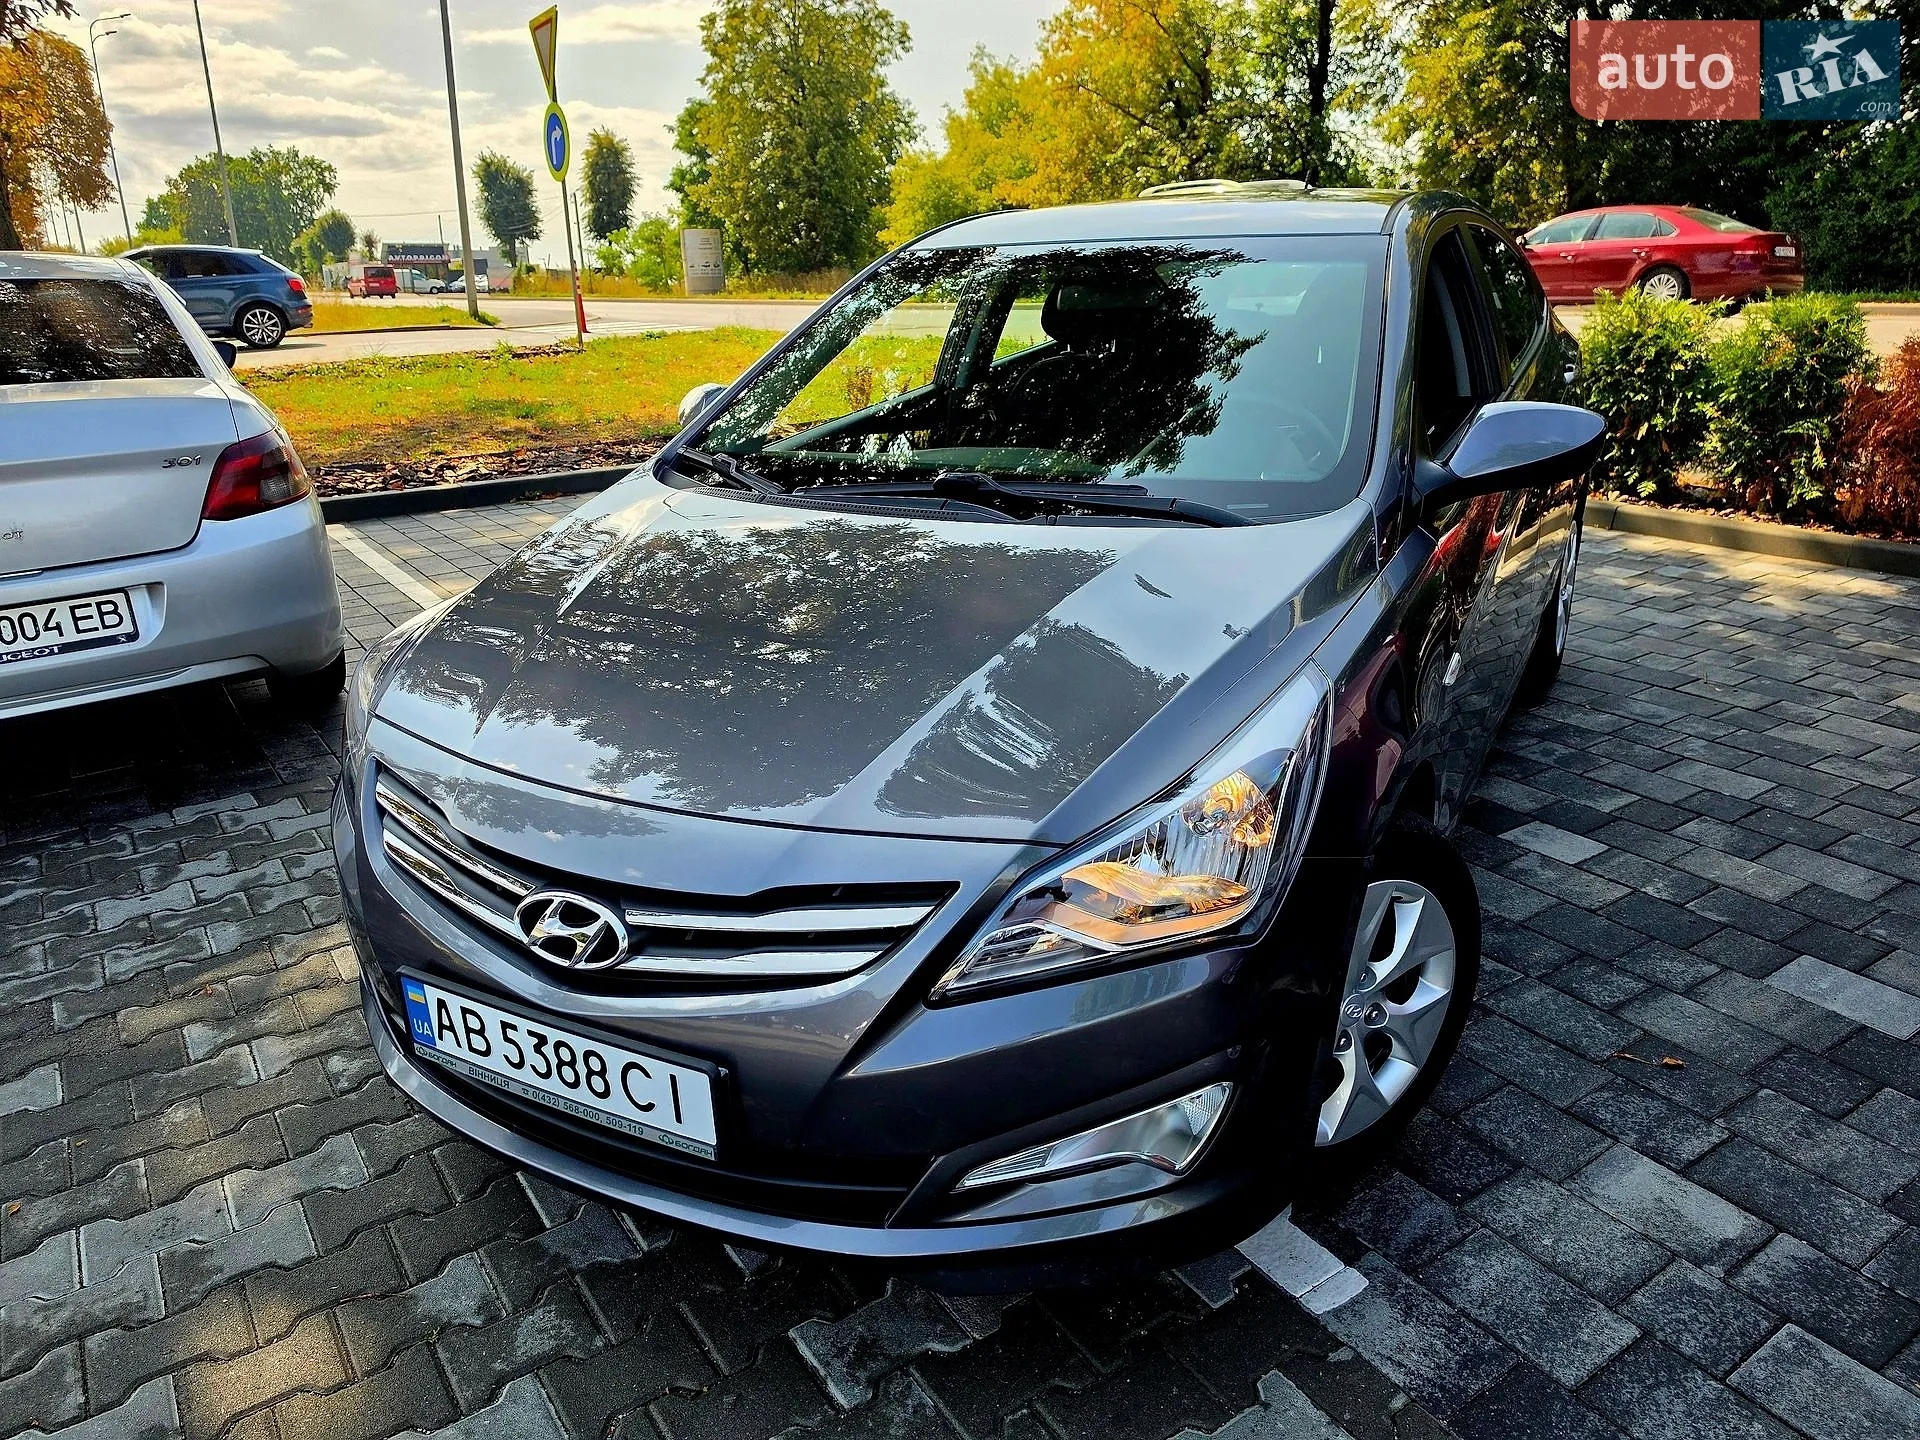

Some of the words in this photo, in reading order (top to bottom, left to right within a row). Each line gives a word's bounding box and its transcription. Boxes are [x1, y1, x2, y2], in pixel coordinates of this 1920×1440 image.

[162, 455, 201, 469] 301
[69, 599, 125, 635] EB
[413, 1017, 434, 1038] UA
[435, 997, 492, 1058] AB
[499, 1018, 612, 1101] 5388
[468, 1067, 511, 1089] ВІННИЦЯ
[532, 1090, 560, 1109] 0(432)
[606, 1117, 644, 1135] 509-119
